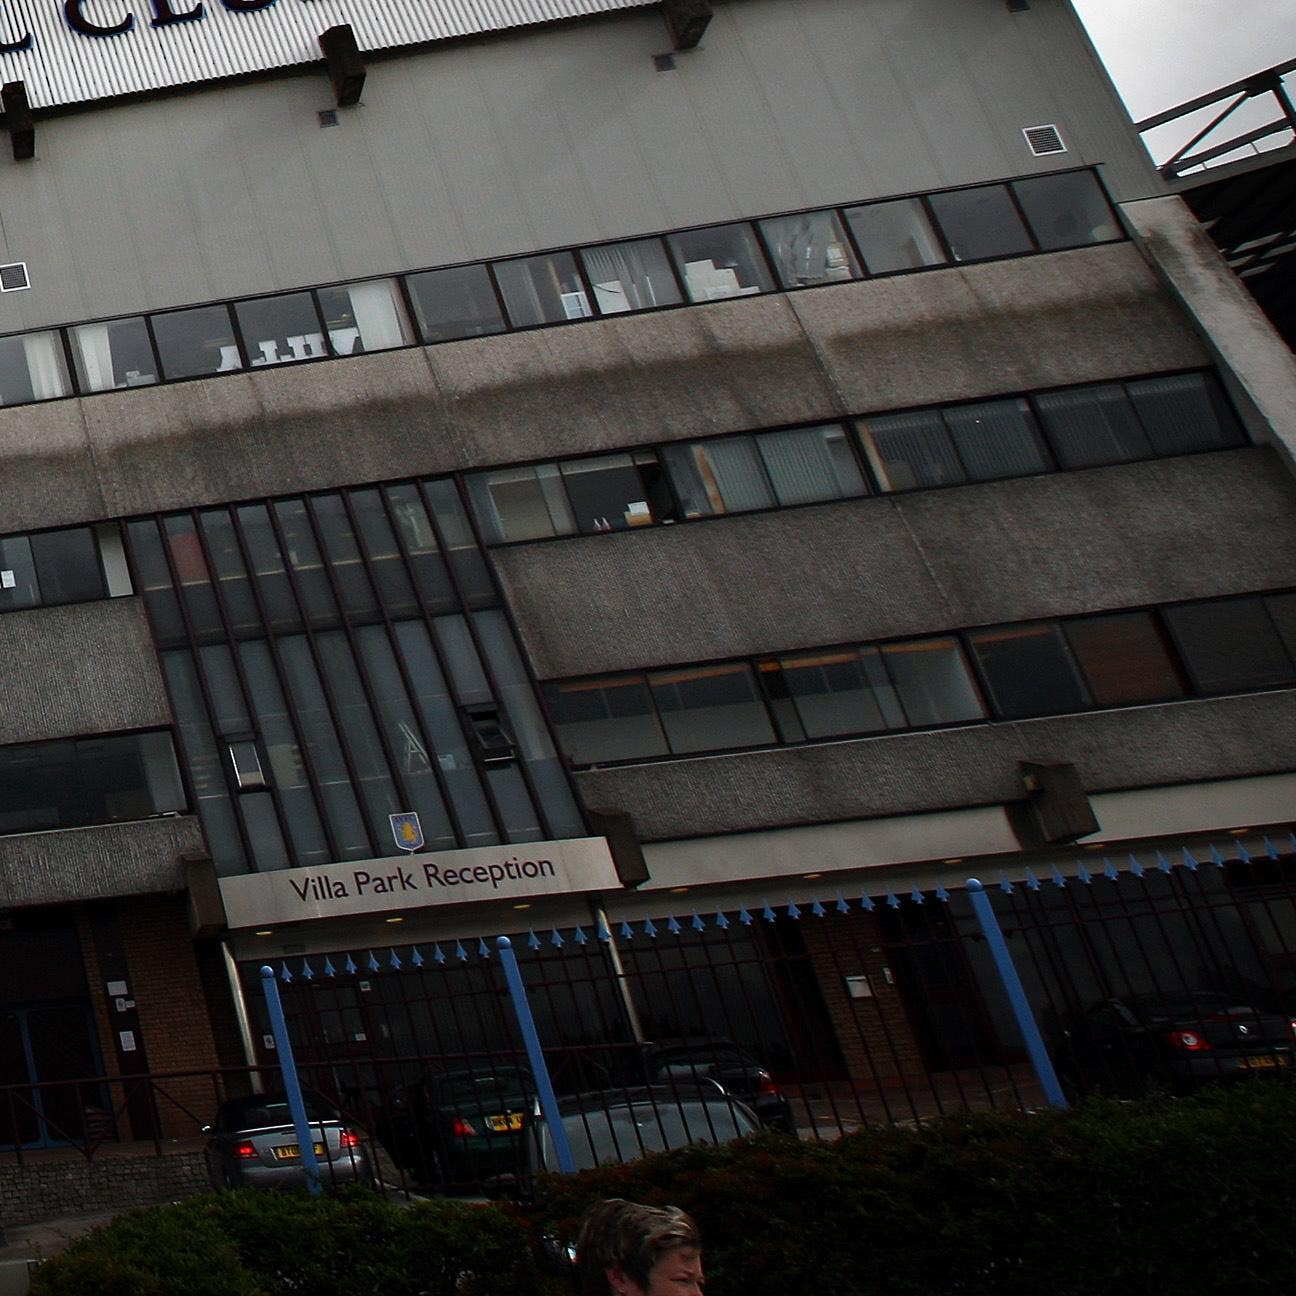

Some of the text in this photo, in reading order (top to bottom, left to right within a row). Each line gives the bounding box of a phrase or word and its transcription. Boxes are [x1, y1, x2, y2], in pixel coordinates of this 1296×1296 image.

[289, 855, 556, 902] Villa Park Reception
